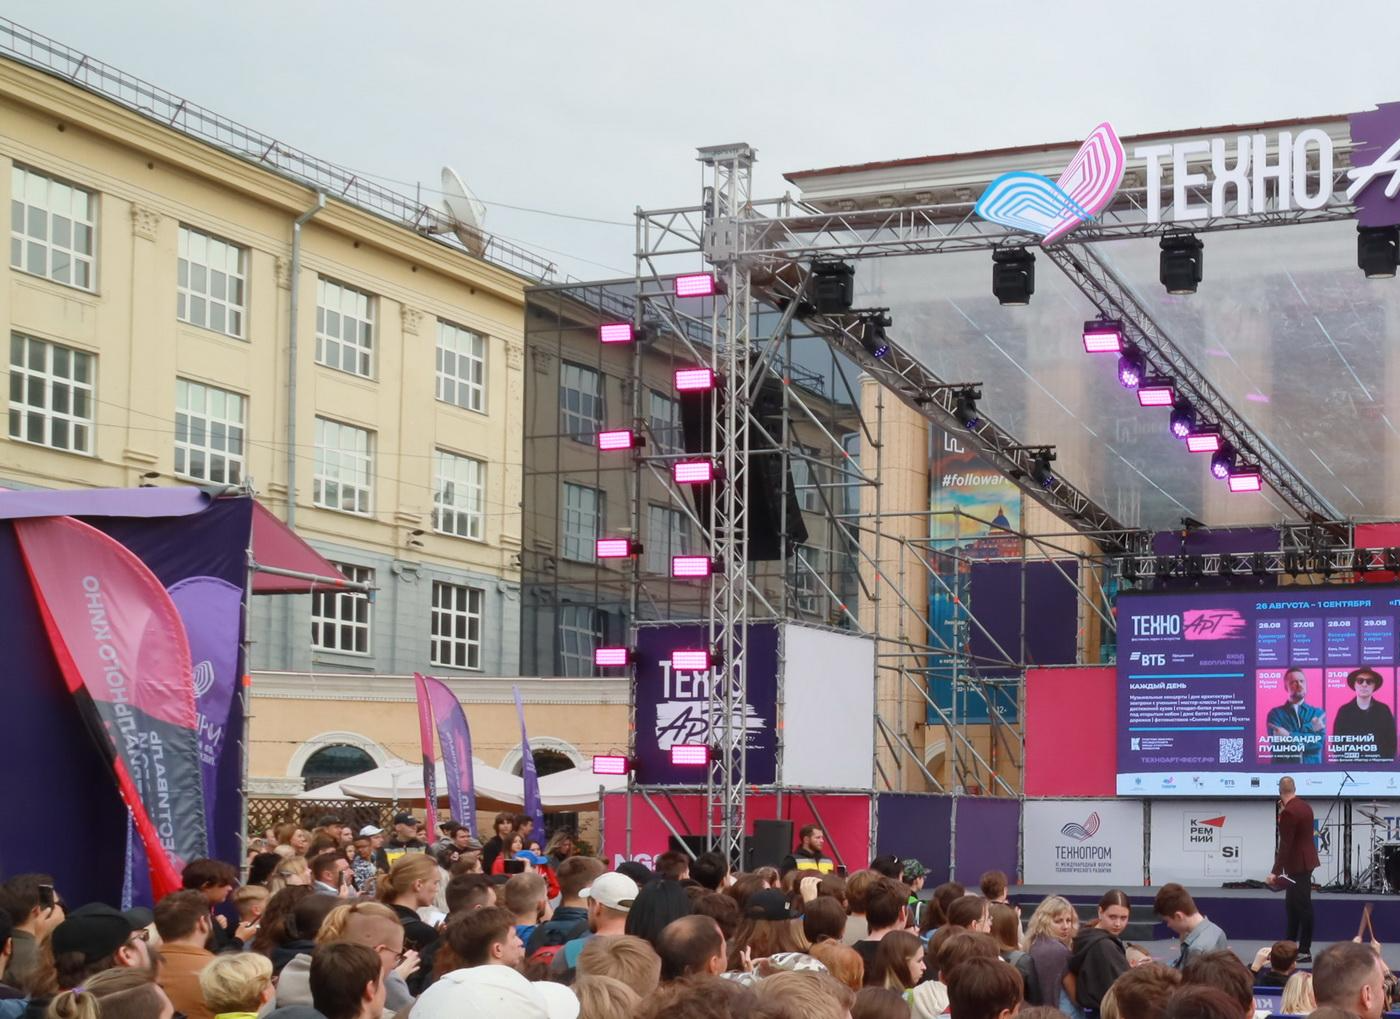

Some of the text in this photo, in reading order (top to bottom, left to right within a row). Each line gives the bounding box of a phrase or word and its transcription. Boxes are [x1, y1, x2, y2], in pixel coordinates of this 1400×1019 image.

[1134, 129, 1333, 224] ТЕХНО
[1268, 602, 1310, 610] АВГУСТА
[1322, 600, 1372, 608] СЕНТЯБРЯ
[1131, 614, 1180, 636] ТЕХНО
[1142, 654, 1166, 666] ВТБ
[1130, 682, 1166, 690] КАЖДЫЙ
[1258, 735, 1322, 743] АЛЕКСАНДР
[1328, 733, 1374, 742] ЕВГЕНИЙ
[1258, 744, 1306, 752] ПУШНОЙ
[1328, 744, 1378, 753] ЦЫГАНОВ
[1190, 827, 1213, 835] РЕМ
[1190, 833, 1213, 843] НИЙ
[1055, 846, 1112, 860] ТЕХНОПРОМ
[1222, 846, 1239, 858] Si
